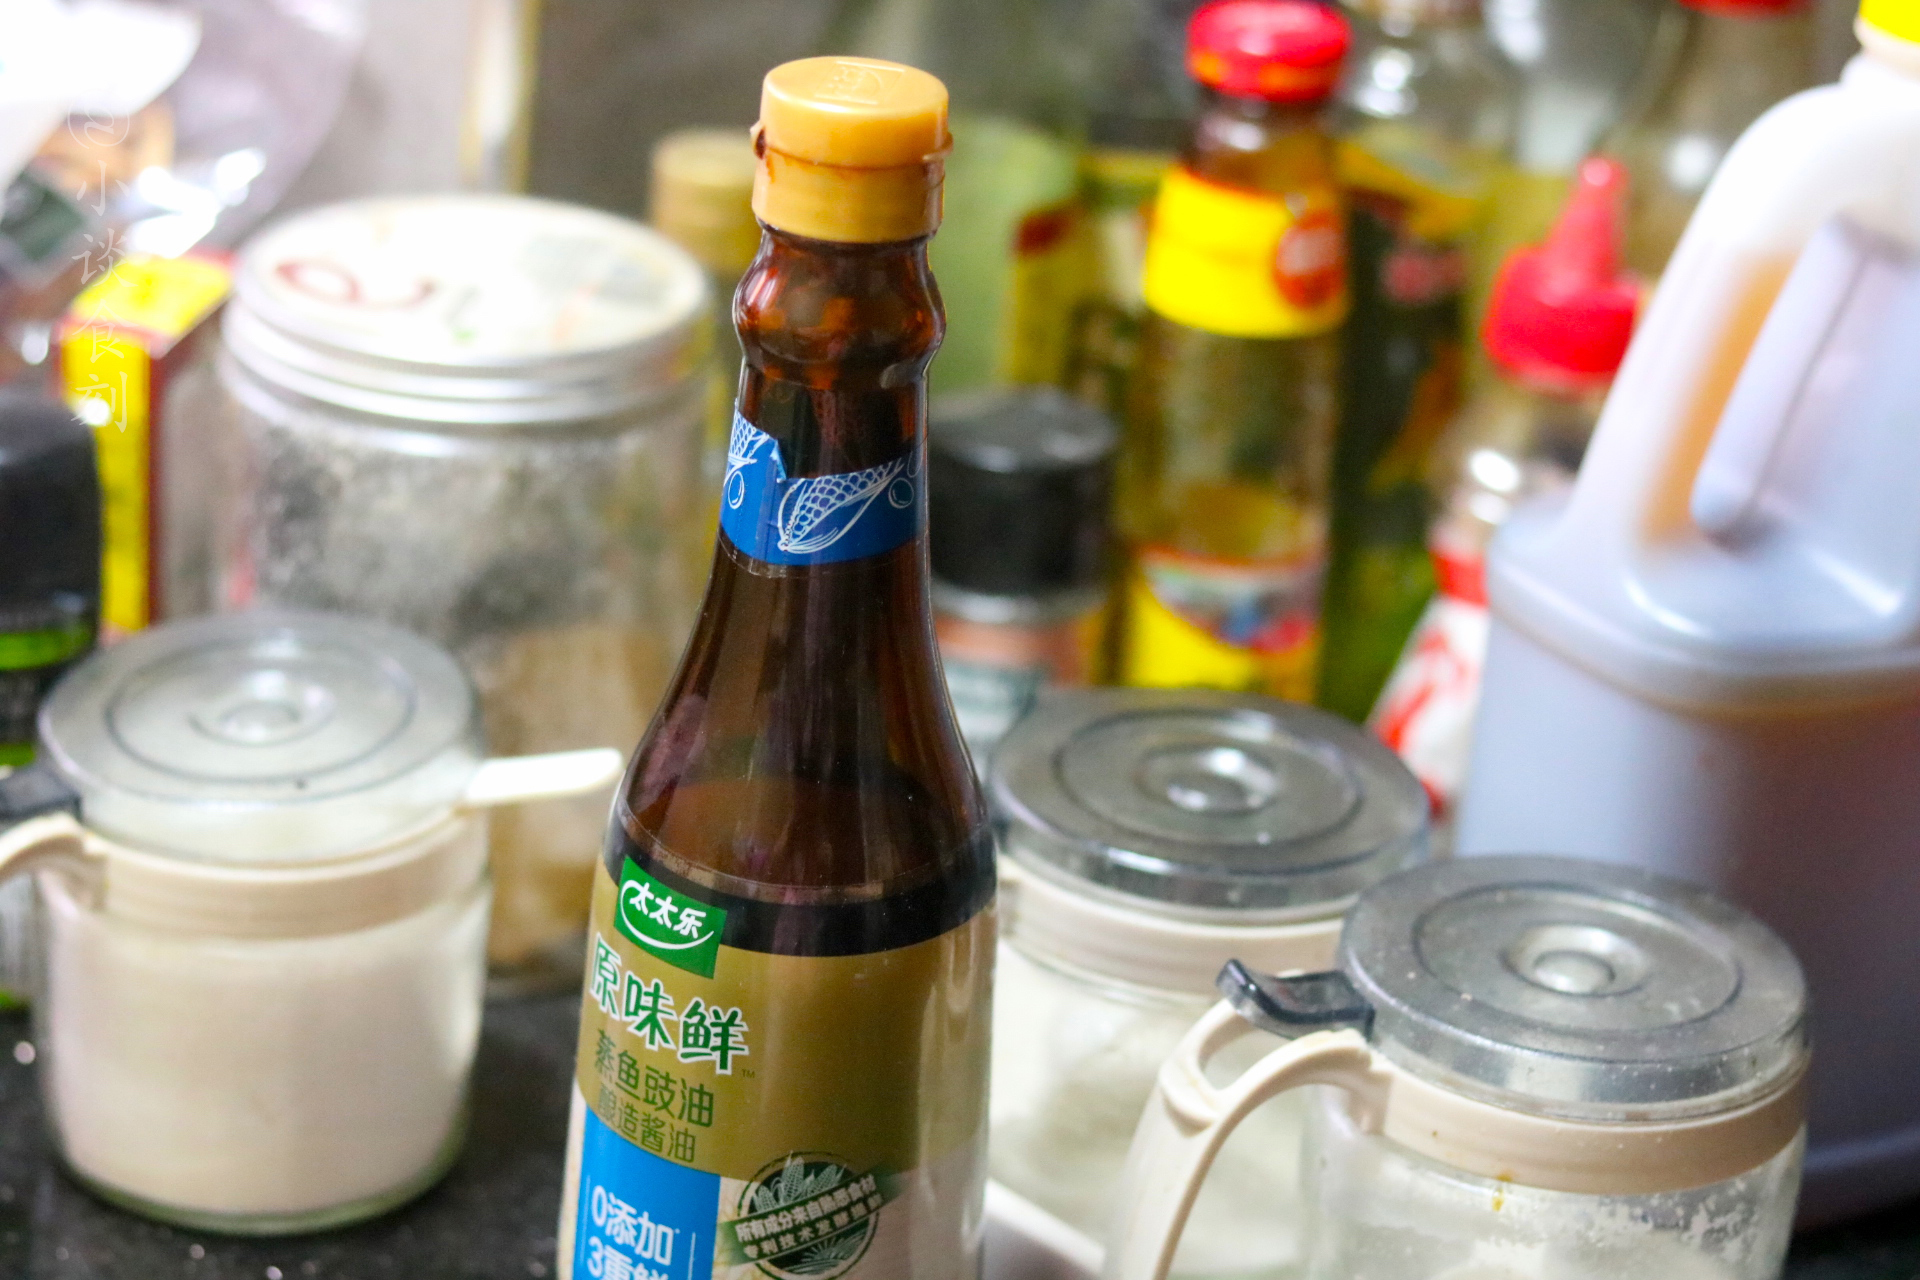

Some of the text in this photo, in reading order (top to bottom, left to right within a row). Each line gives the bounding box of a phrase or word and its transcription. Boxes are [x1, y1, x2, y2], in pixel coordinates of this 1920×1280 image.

[629, 881, 707, 939] 太太乐
[588, 931, 750, 1075] 原味鲜
[594, 1028, 714, 1128] 蒸鱼豉油
